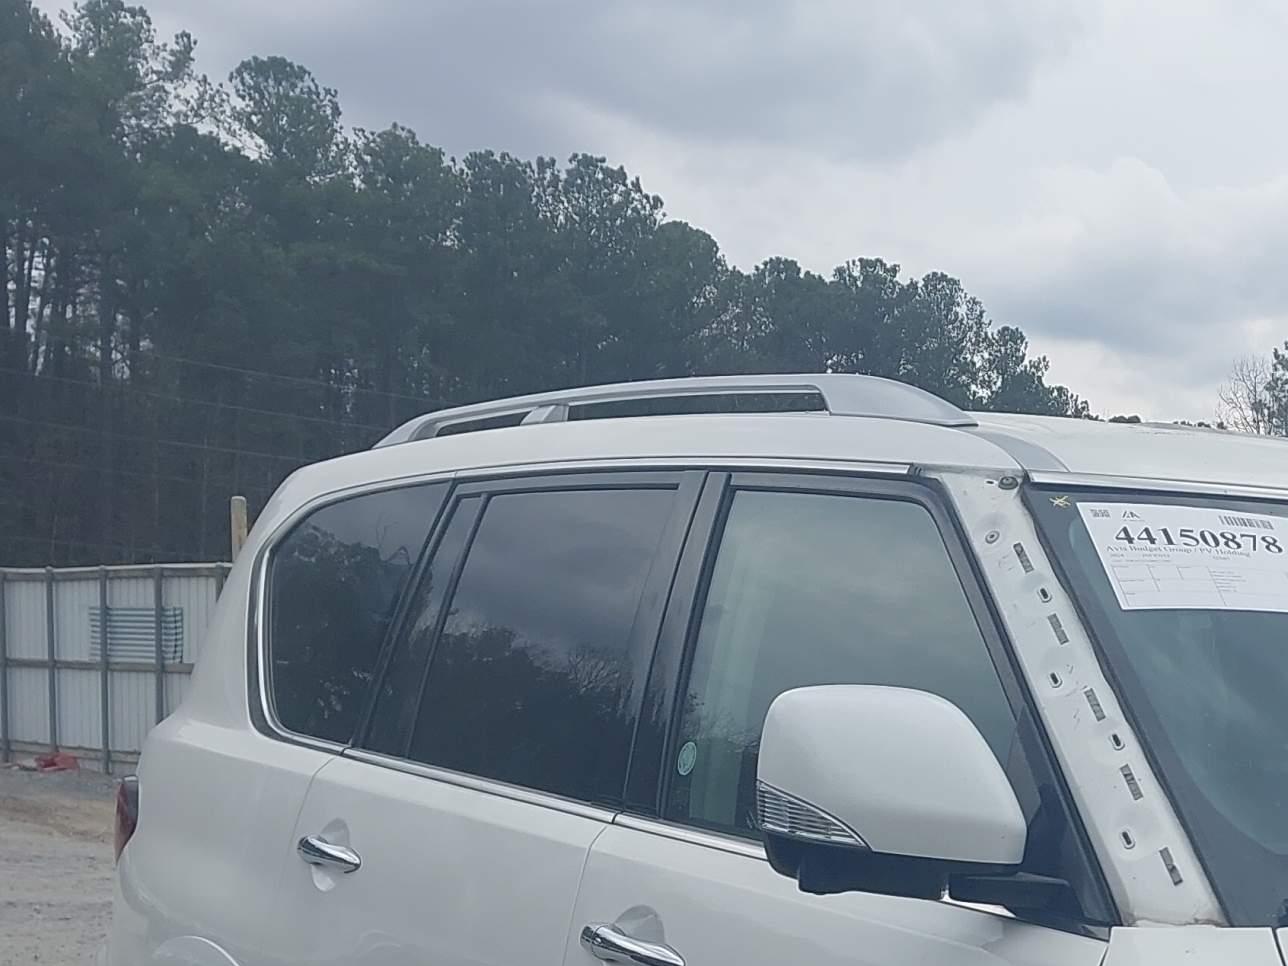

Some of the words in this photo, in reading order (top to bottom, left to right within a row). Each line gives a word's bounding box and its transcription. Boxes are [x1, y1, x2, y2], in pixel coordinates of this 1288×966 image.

[1115, 526, 1284, 554] 44150878
[1107, 545, 1128, 553] Avis
[1129, 545, 1162, 554] Budget
